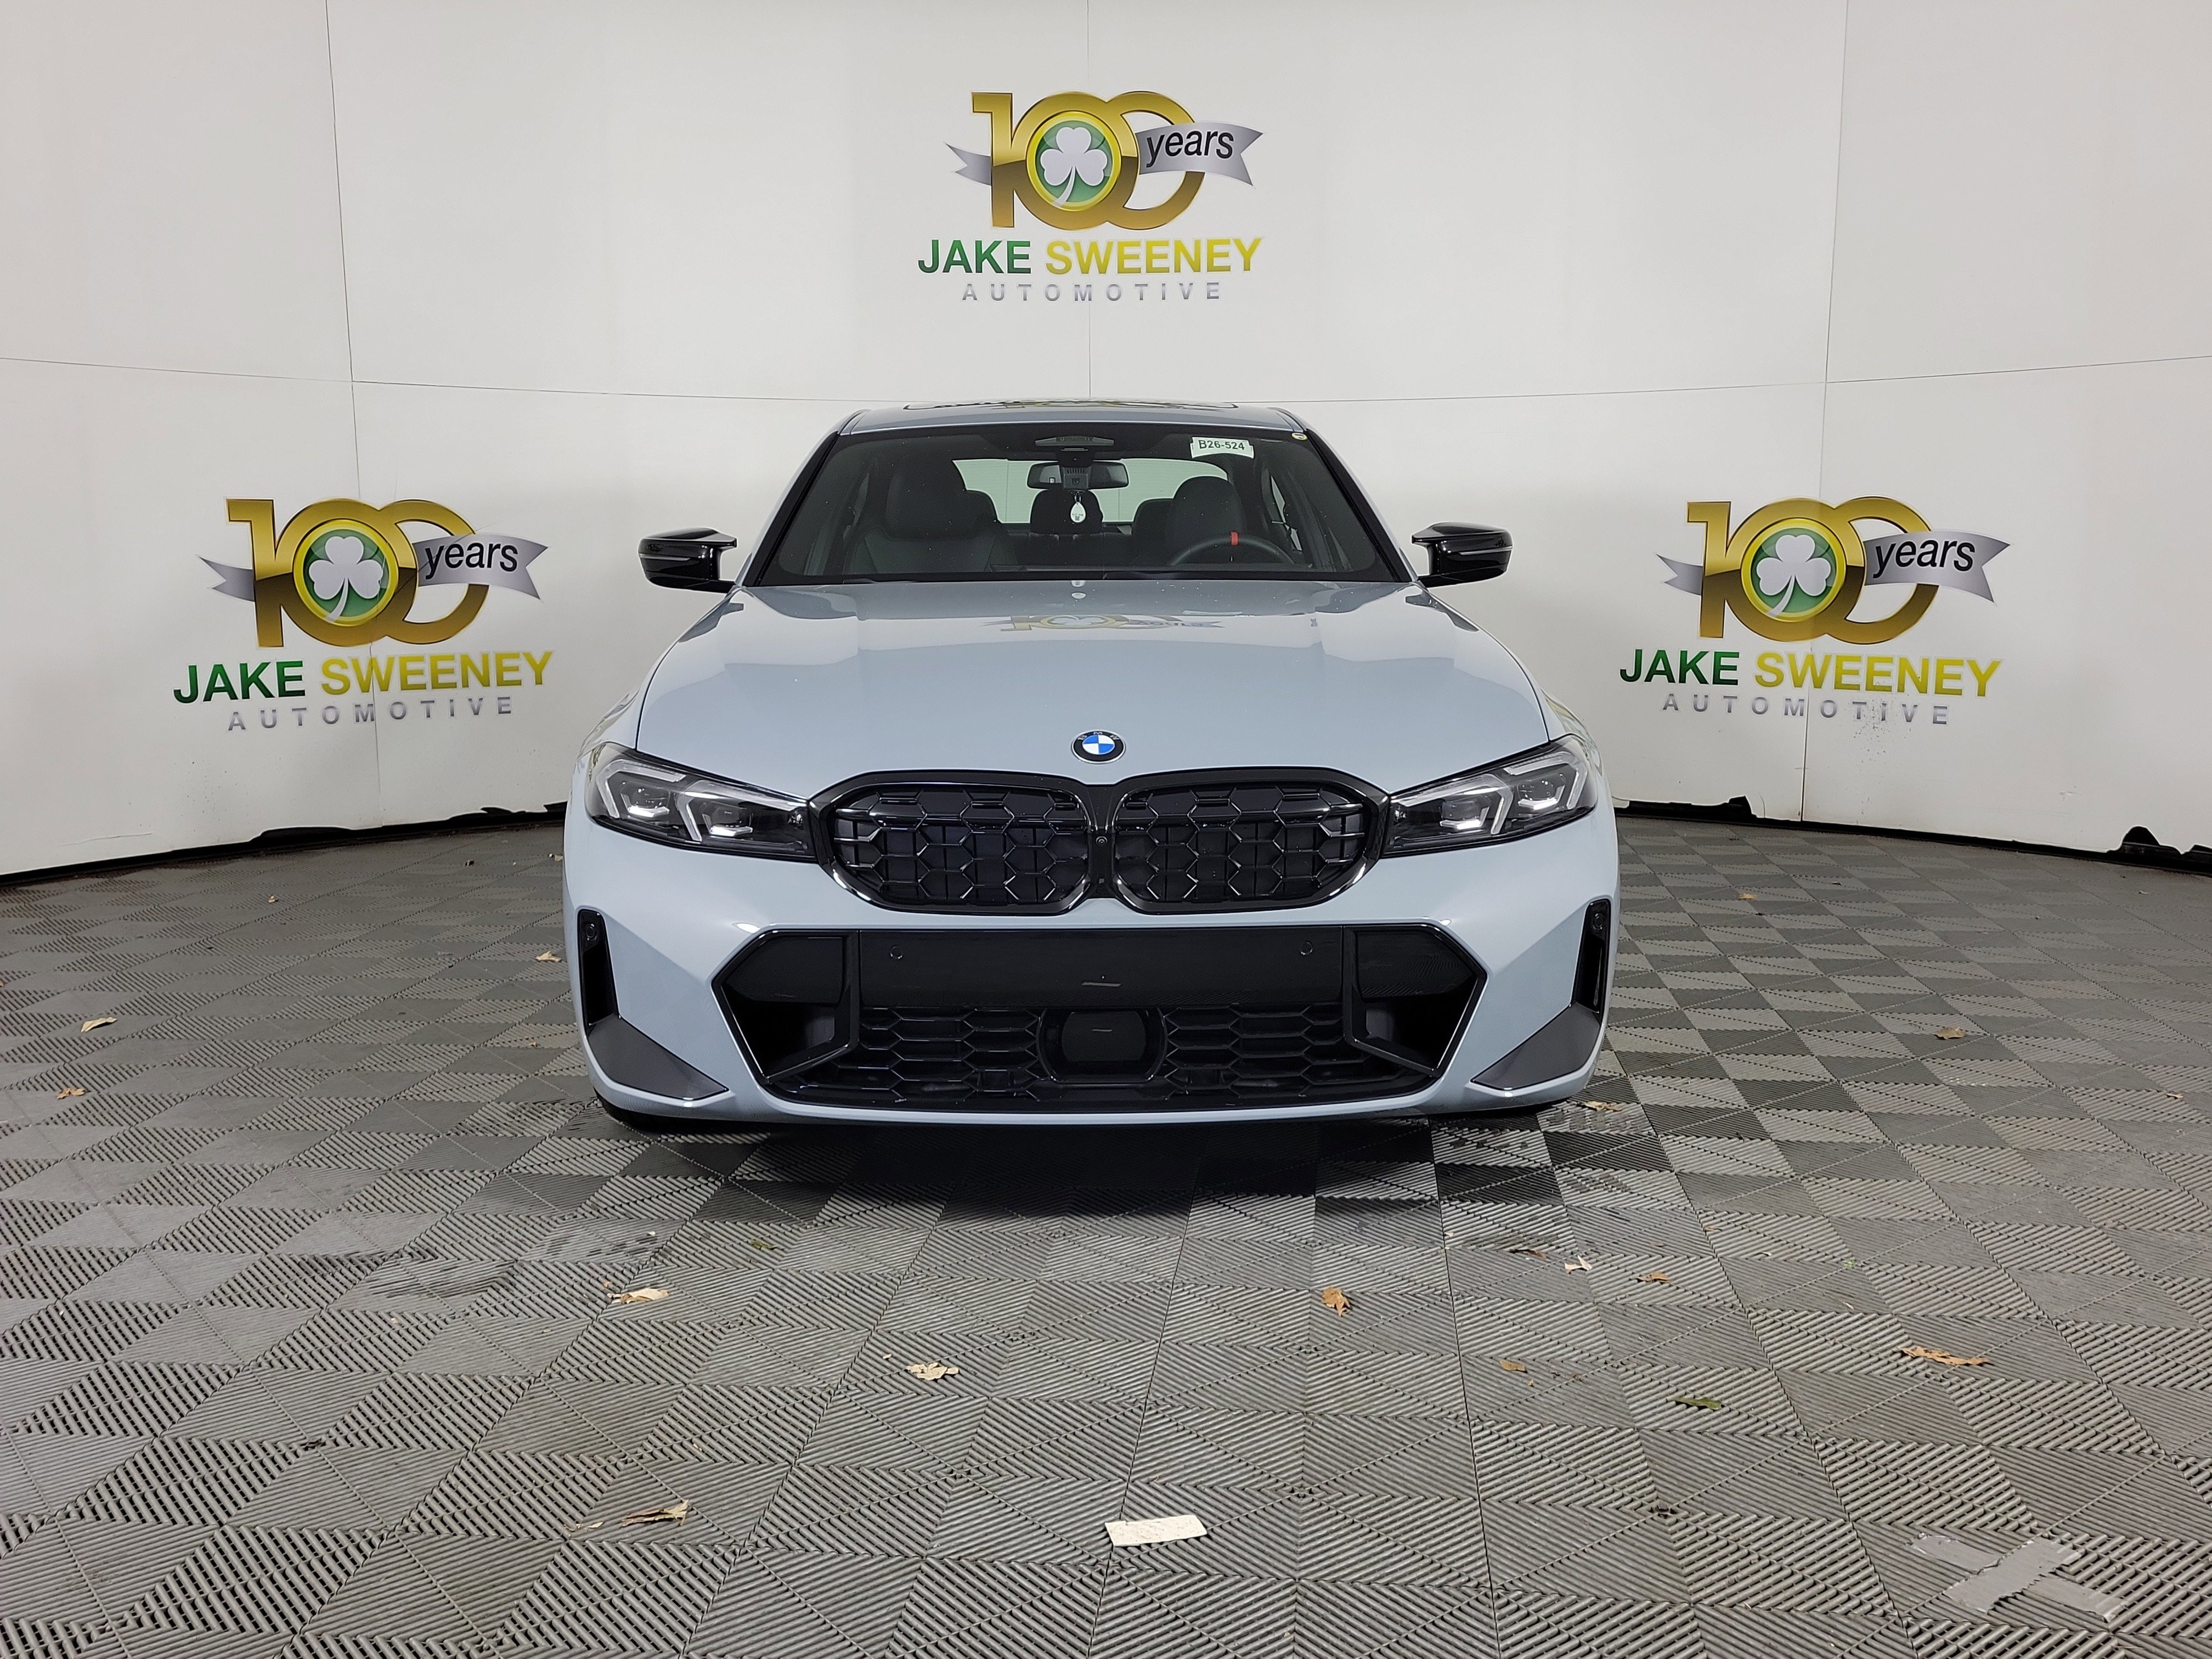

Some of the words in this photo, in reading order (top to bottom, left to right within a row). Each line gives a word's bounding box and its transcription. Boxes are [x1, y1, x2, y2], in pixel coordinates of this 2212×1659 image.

[972, 91, 1205, 230] 100
[1146, 131, 1233, 167] years
[918, 239, 1031, 274] JAKE
[1046, 237, 1262, 274] SWEENEY
[962, 282, 1220, 302] AUTOMOTIVE
[1198, 439, 1245, 450] B26-524
[226, 498, 489, 647] 100
[425, 542, 518, 579] years
[1686, 496, 1939, 645] 100
[1872, 539, 1975, 579] years
[173, 660, 306, 703] JAKE
[321, 652, 552, 696] SWEENEY
[1620, 648, 1740, 685] JAKE
[1756, 652, 2001, 697] SWEENEY
[228, 696, 511, 731] AUTOMOTIVE
[1662, 693, 1947, 725] AUTOMOTIVE
[1077, 731, 1120, 741] BMW
